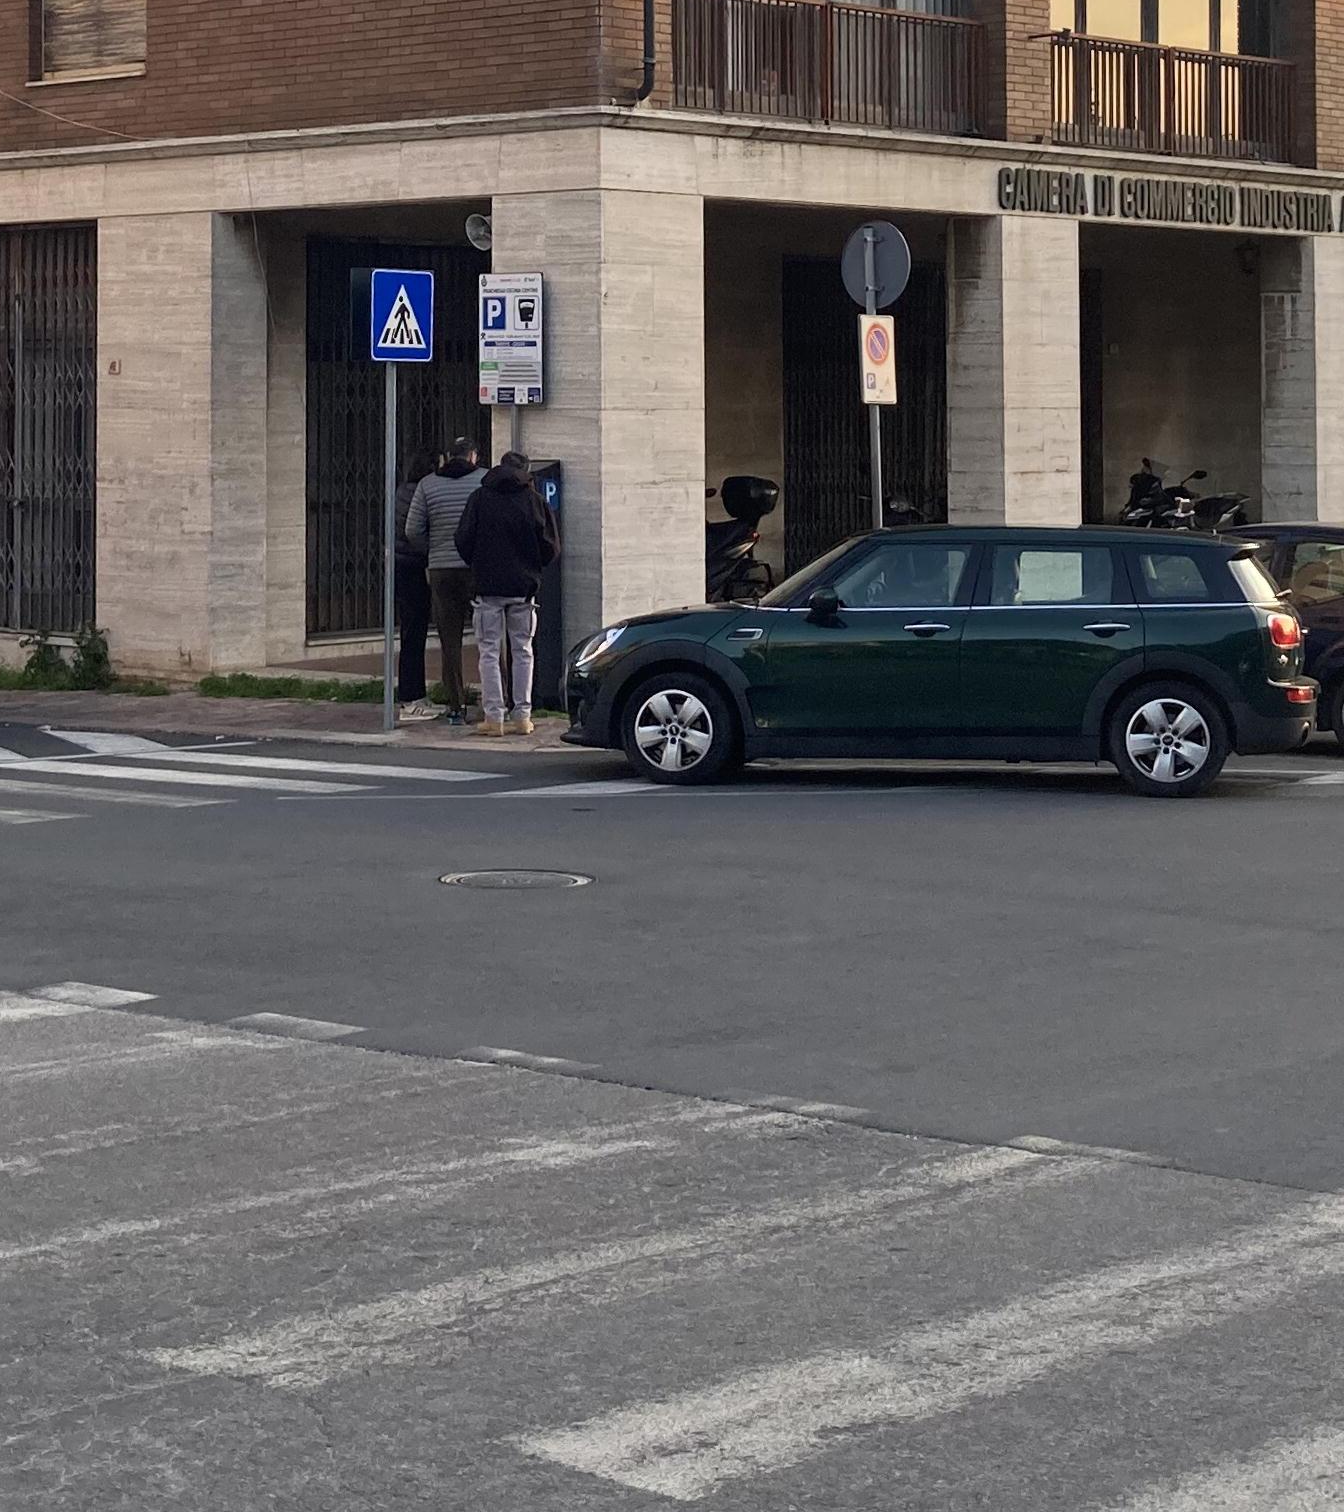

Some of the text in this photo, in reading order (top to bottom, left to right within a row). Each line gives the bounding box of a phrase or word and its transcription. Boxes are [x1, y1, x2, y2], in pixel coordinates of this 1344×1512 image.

[997, 167, 1089, 215] CAMERA
[1093, 174, 1116, 217] DI
[1119, 177, 1237, 226] COMMERCIO
[1239, 185, 1336, 234] INDUSTRIA
[487, 299, 502, 327] P
[546, 481, 556, 503] P
